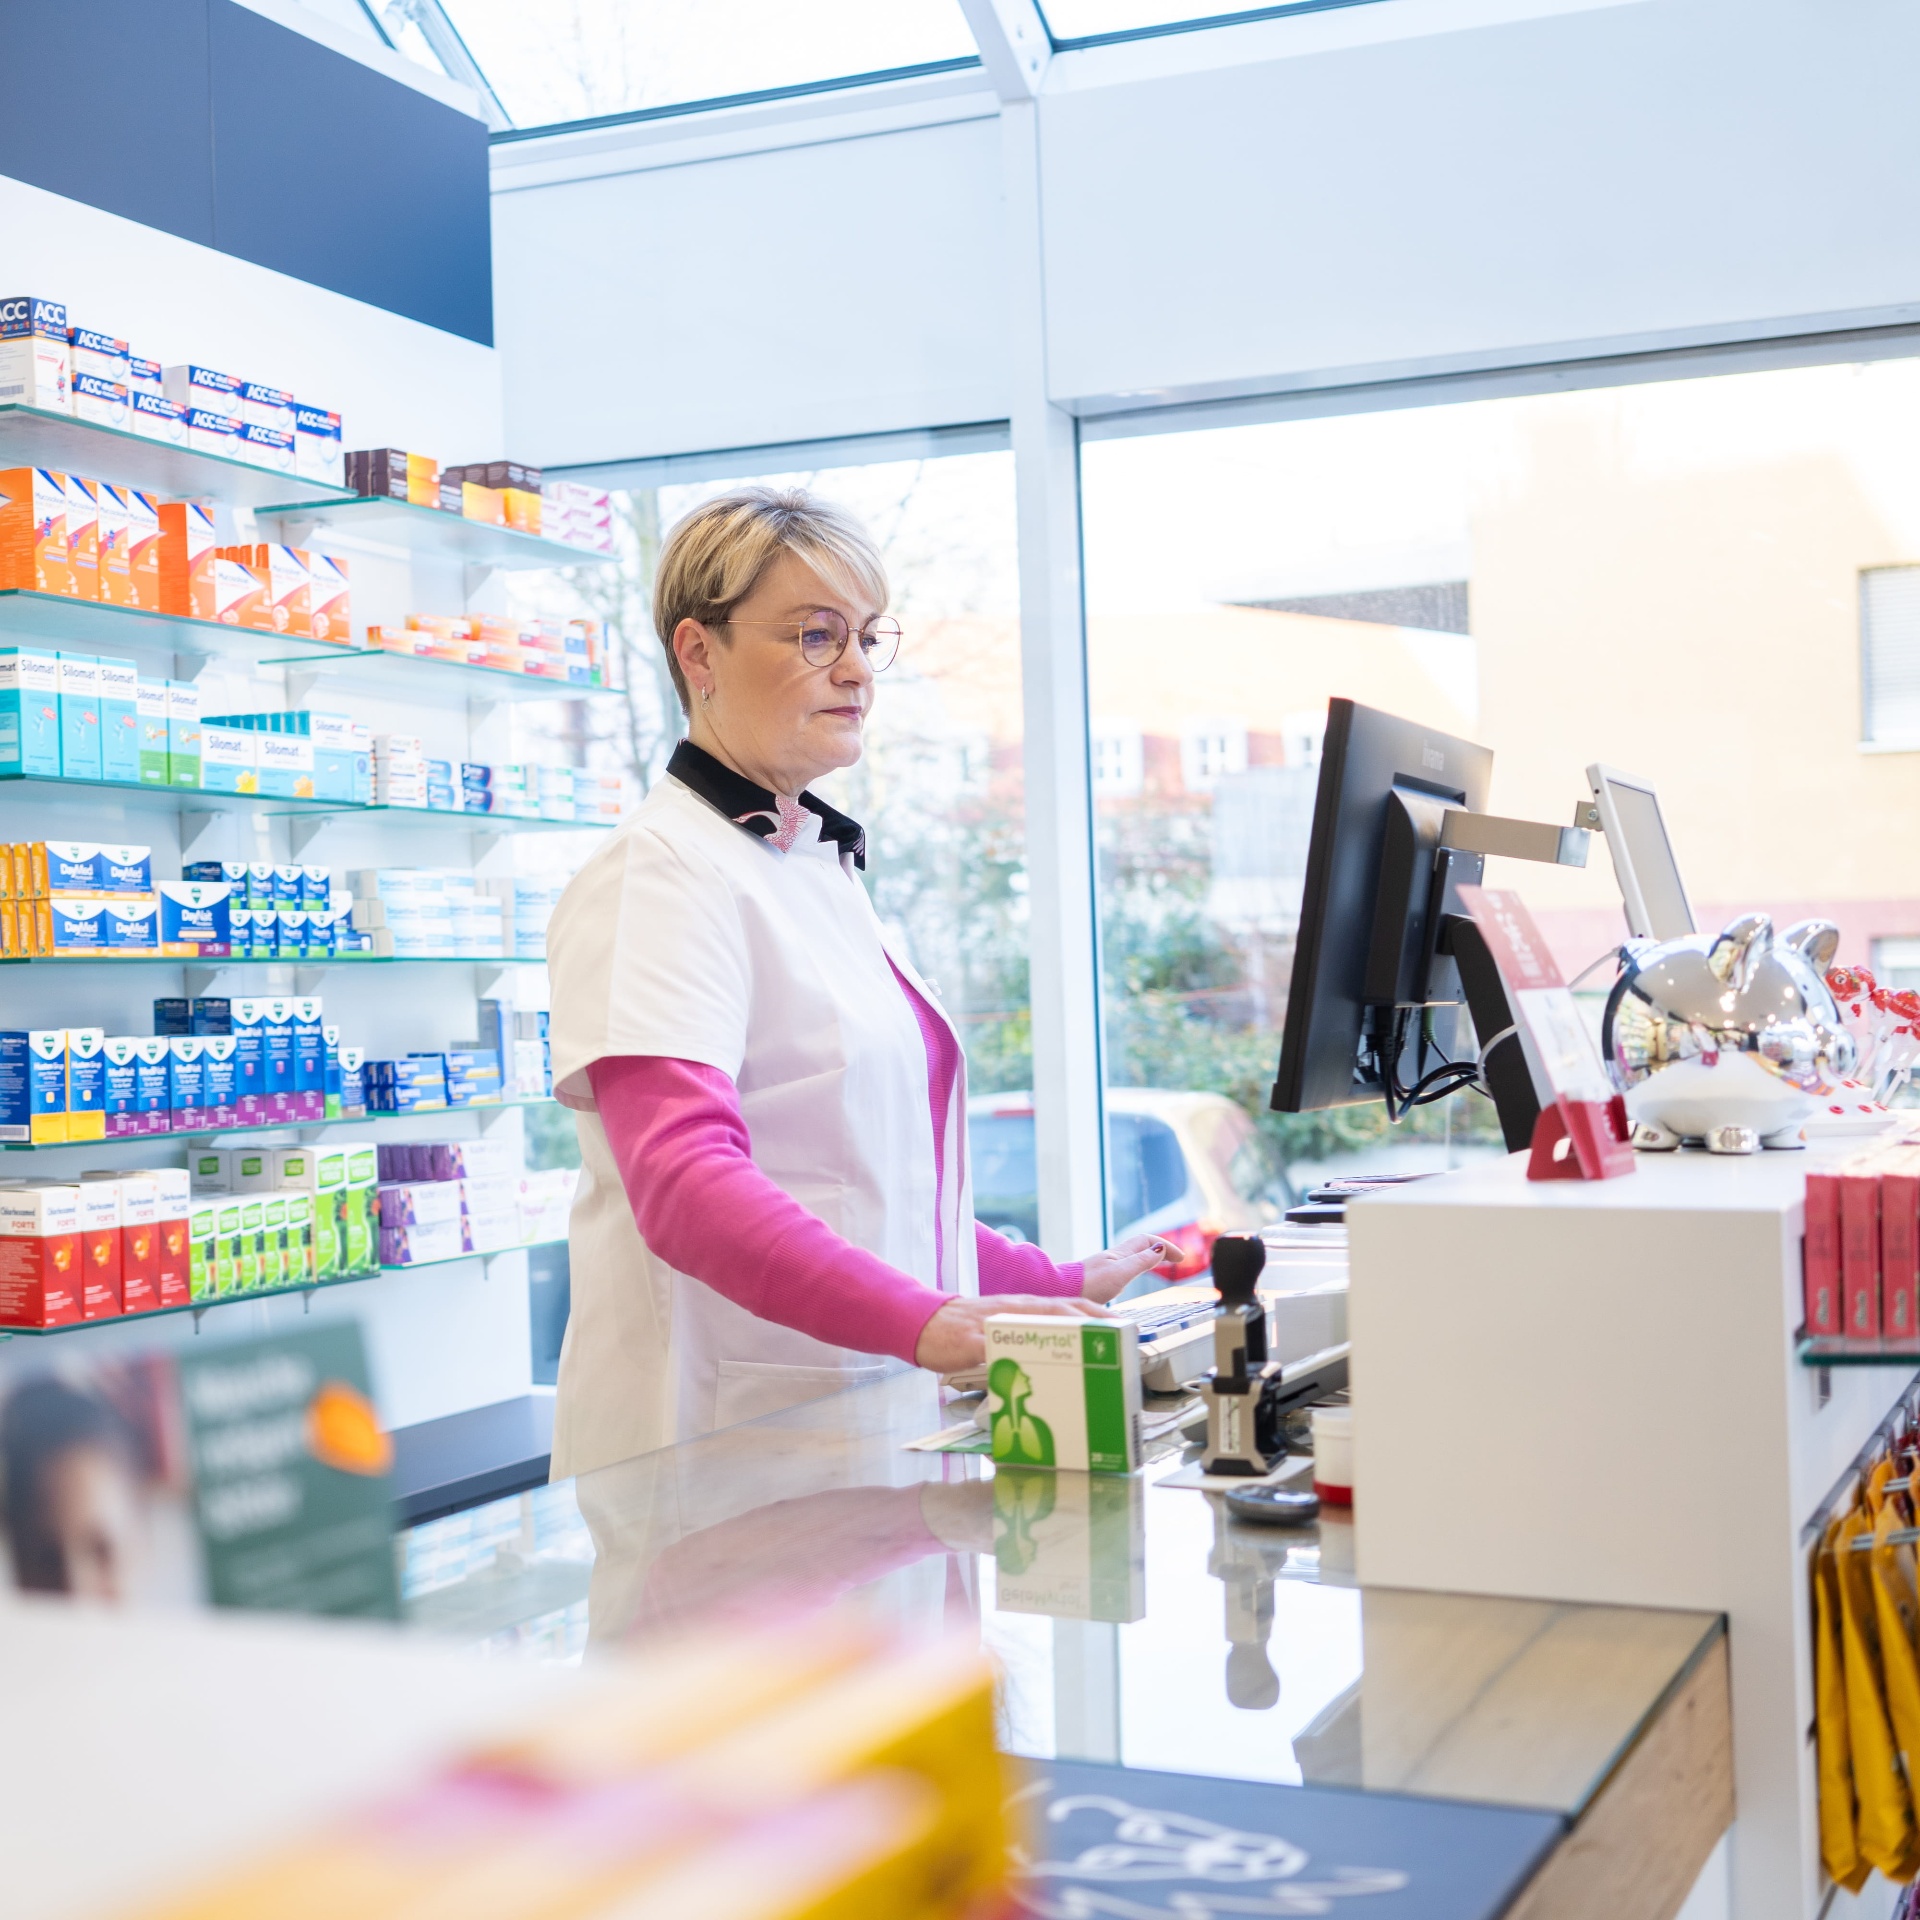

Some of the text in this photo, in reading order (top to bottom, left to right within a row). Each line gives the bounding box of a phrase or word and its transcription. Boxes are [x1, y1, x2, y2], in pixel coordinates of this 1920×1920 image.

[34, 302, 65, 325] ACC
[78, 331, 102, 350] ACC
[80, 376, 102, 396] ACC
[193, 369, 215, 387] ACC
[246, 385, 269, 402] ACC
[137, 394, 160, 413] ACC
[192, 411, 216, 430] ACC
[297, 410, 318, 428] ACC
[247, 425, 269, 443] ACC
[21, 659, 55, 675] Silomat
[62, 665, 96, 680] Silomat
[101, 669, 134, 684] Silomat
[137, 688, 164, 701] Silomat
[170, 692, 198, 706] Silomat
[315, 719, 343, 732] Silomat
[209, 735, 242, 752] Silomat
[265, 741, 299, 756] Silomat
[96, 1214, 115, 1222] FORTE
[136, 1209, 154, 1218] FORTE
[11, 1220, 36, 1230] FORTE
[57, 1218, 76, 1227] FORTE
